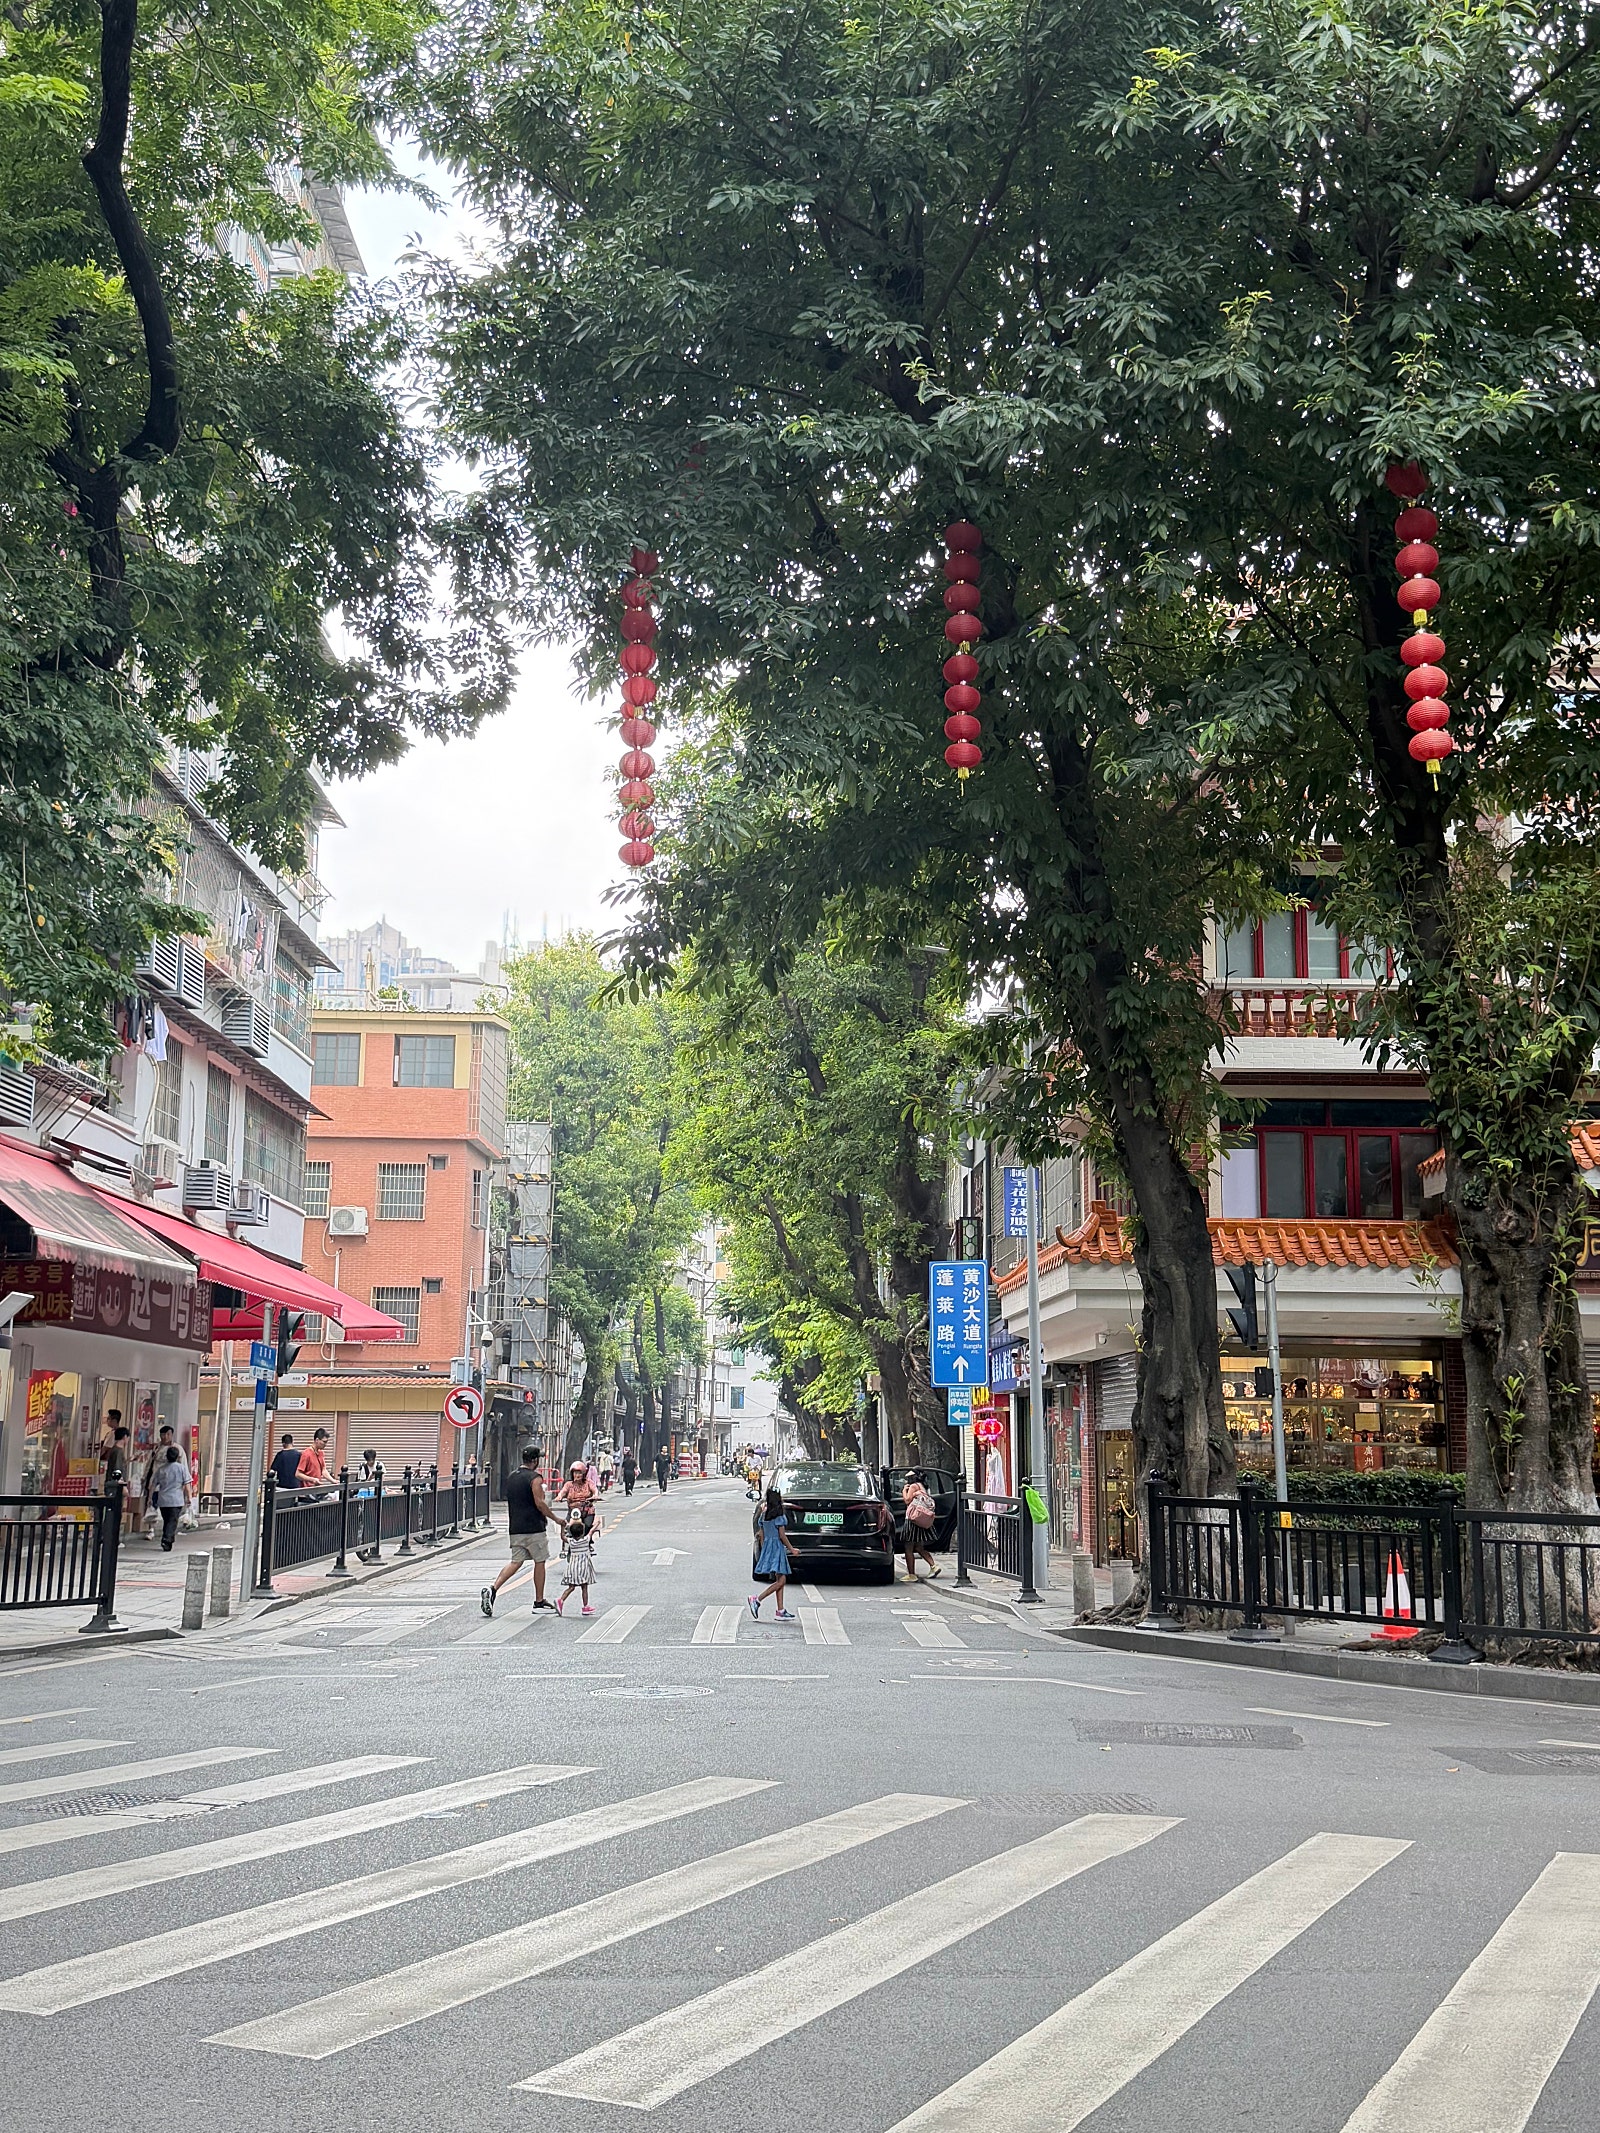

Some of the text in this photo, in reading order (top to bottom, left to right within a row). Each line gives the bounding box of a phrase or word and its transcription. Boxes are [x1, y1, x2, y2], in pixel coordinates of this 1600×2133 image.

[2, 1264, 64, 1284] 老字号
[73, 1280, 95, 1313] 超市
[936, 1268, 955, 1342] 蓬莱路
[962, 1267, 981, 1341] 黄沙大道
